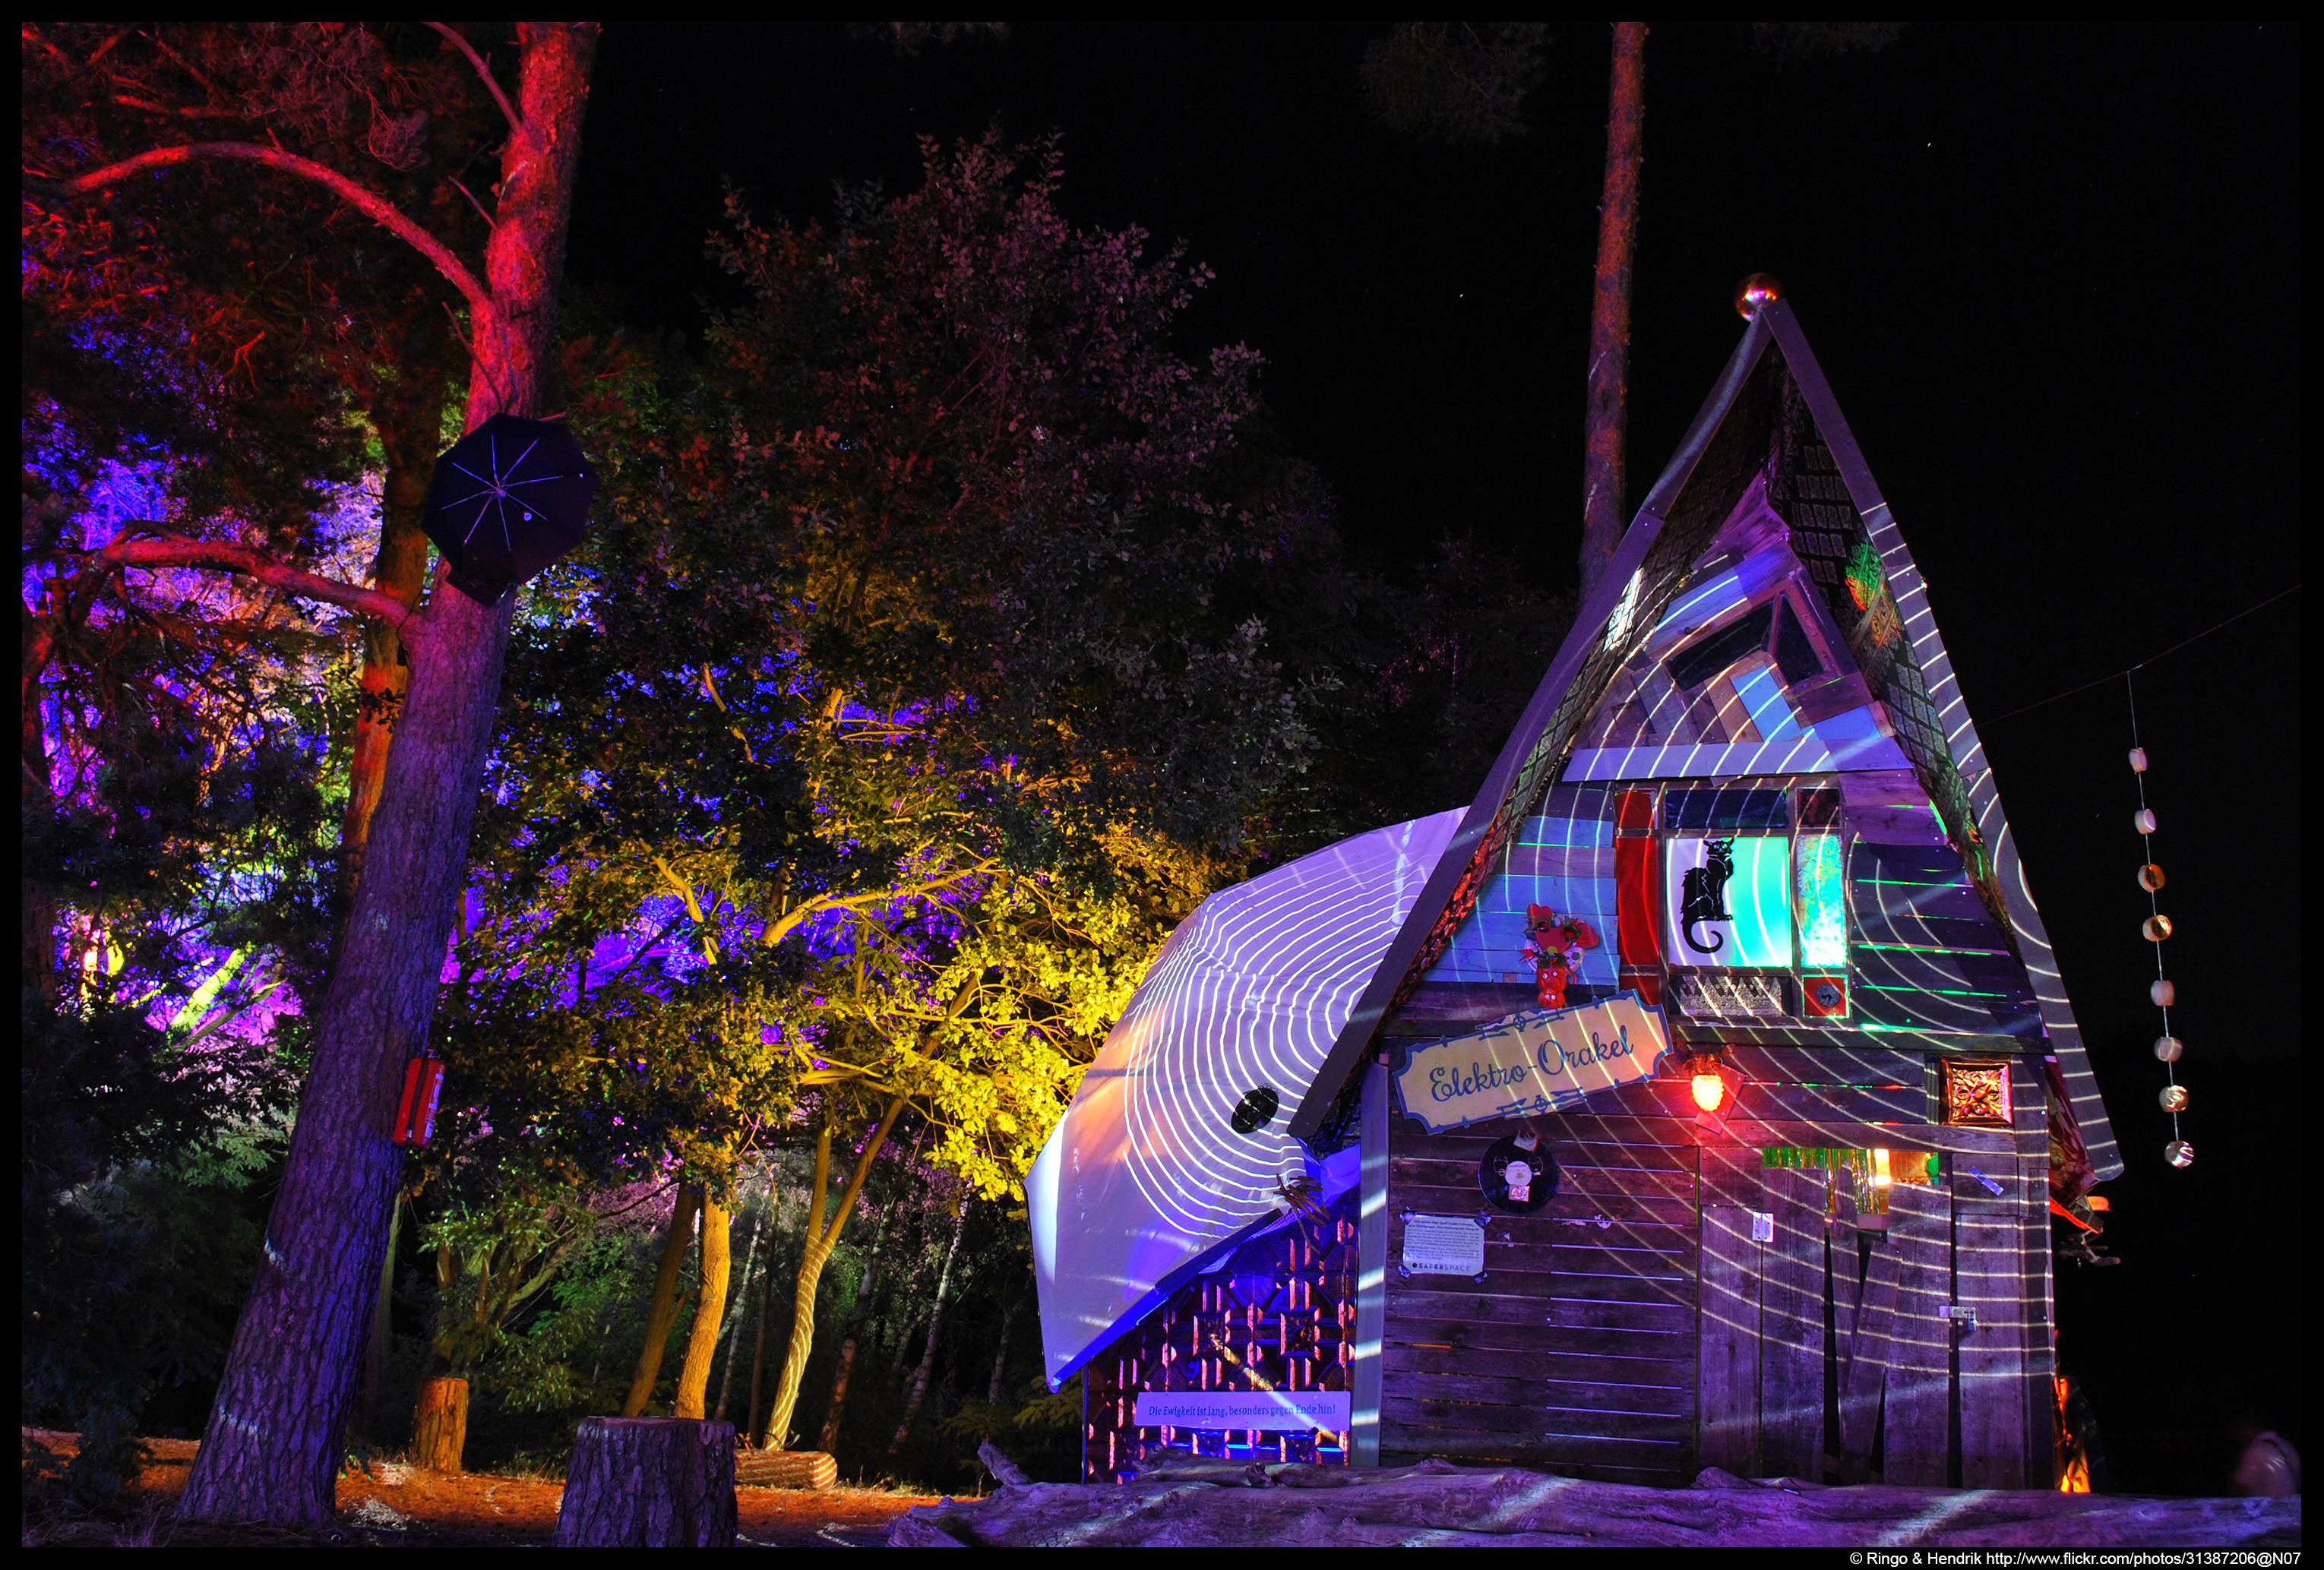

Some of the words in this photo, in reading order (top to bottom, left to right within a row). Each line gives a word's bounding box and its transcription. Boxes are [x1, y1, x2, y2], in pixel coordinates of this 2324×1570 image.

[1429, 1025, 1634, 1102] Elektro-Orakel
[1149, 1406, 1162, 1416] Die
[1163, 1406, 1196, 1418] Ewigkeit
[1197, 1406, 1207, 1417] ist
[1208, 1406, 1228, 1419] lang,
[1228, 1405, 1270, 1416] besonders
[1270, 1406, 1294, 1417] gegen
[1295, 1404, 1317, 1414] Ende
[1318, 1404, 1336, 1414] hin!
